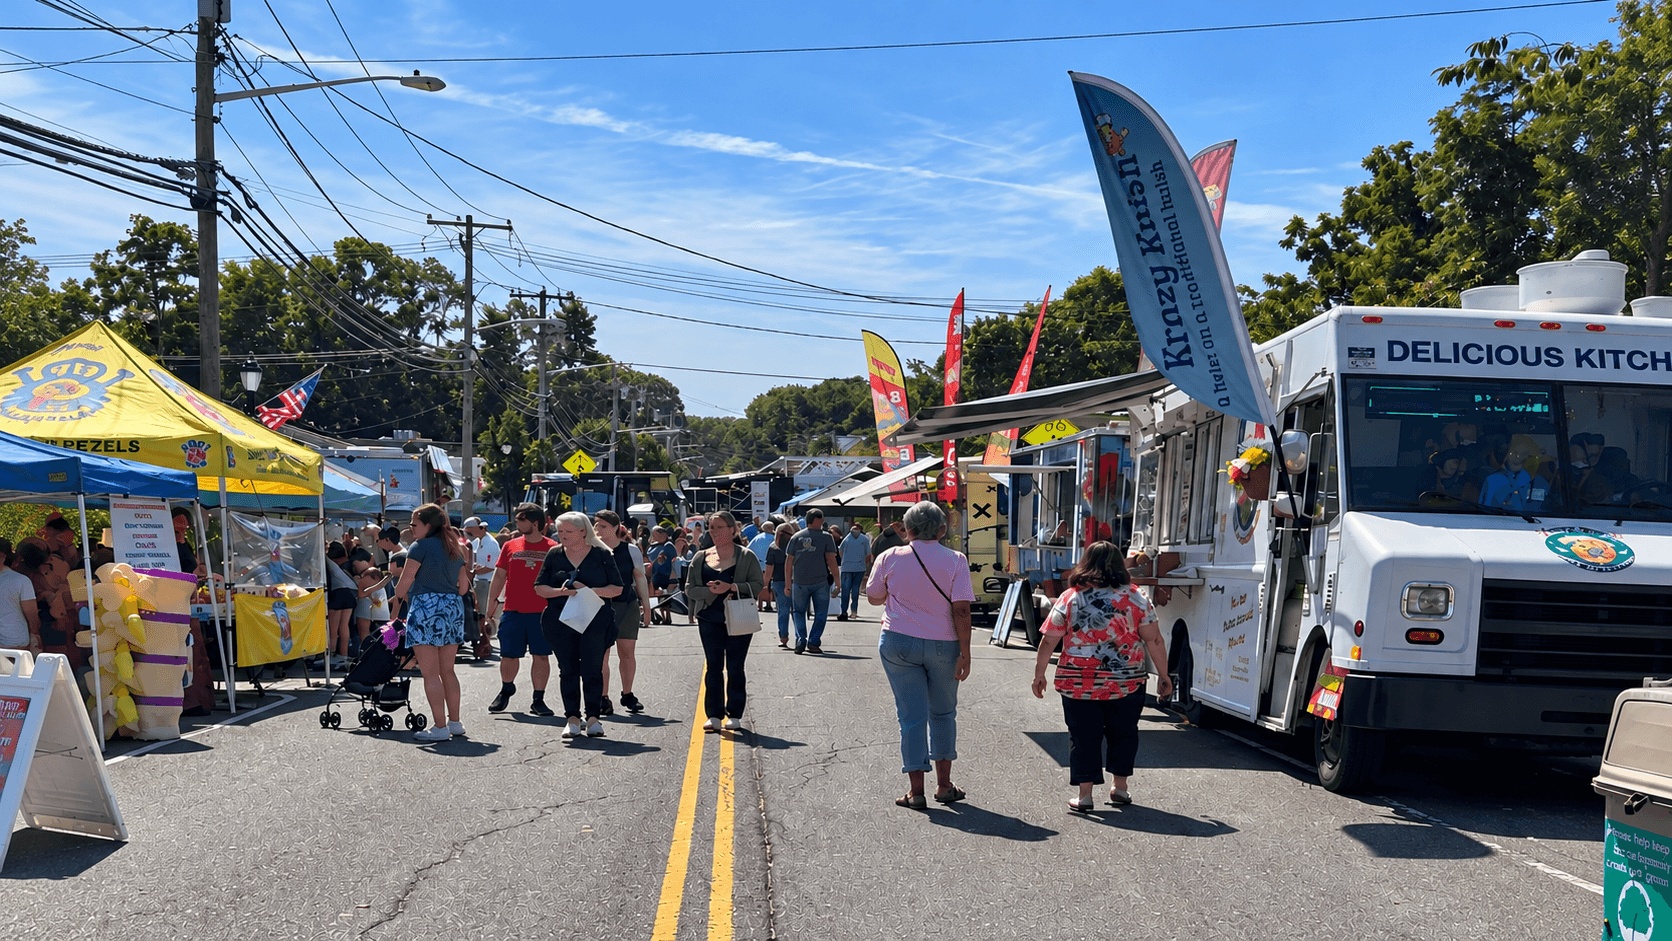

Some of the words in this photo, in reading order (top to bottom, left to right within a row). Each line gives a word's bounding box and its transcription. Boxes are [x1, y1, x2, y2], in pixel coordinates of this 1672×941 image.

[1149, 266, 1195, 371] Krazy
[1387, 339, 1565, 368] DELICIOUS
[1574, 347, 1672, 372] KITCH
